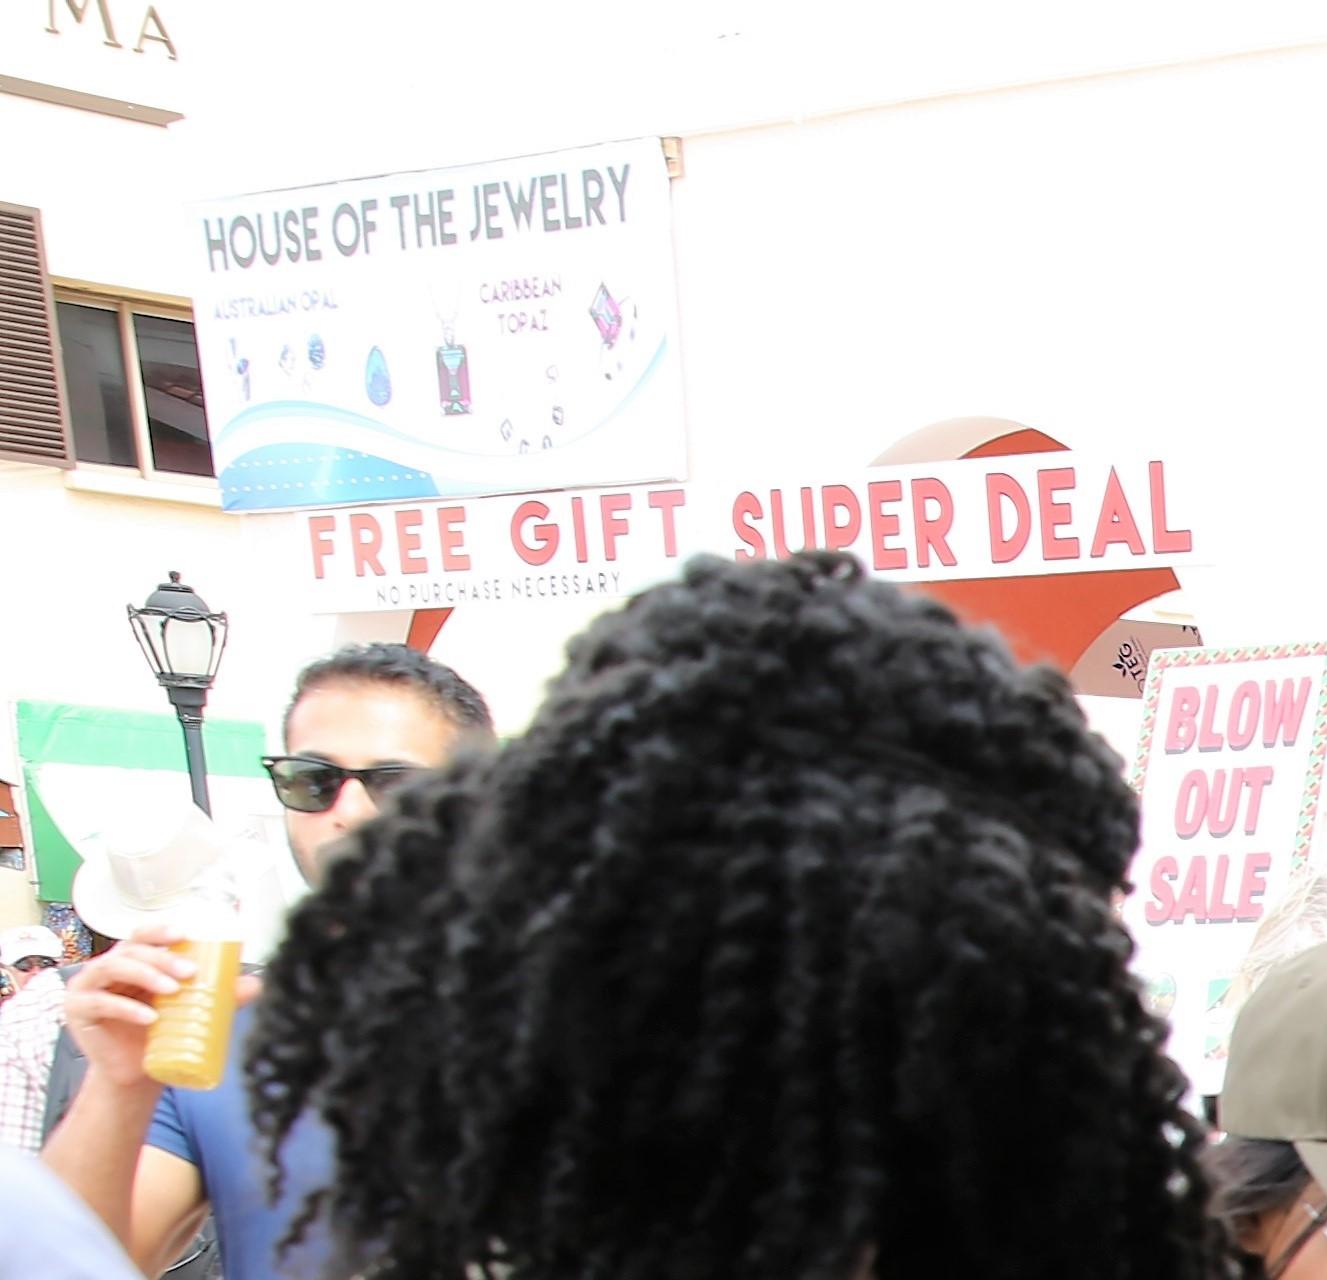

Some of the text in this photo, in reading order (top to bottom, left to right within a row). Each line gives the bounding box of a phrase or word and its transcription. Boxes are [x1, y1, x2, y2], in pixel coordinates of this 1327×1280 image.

[203, 163, 631, 273] HOUSE OF THE JEWELRY
[213, 288, 339, 320] AUSTRALIAN OPAL
[479, 274, 563, 305] CARIBBEAN
[498, 309, 550, 333] TOPAZ
[308, 460, 1193, 580] FREE GIFT SUPER DEAL
[376, 571, 621, 604] NO PURCHASE NECESSARY
[1164, 675, 1313, 755] BLOW
[1174, 765, 1274, 840] OUT
[1144, 852, 1273, 927] SALE
